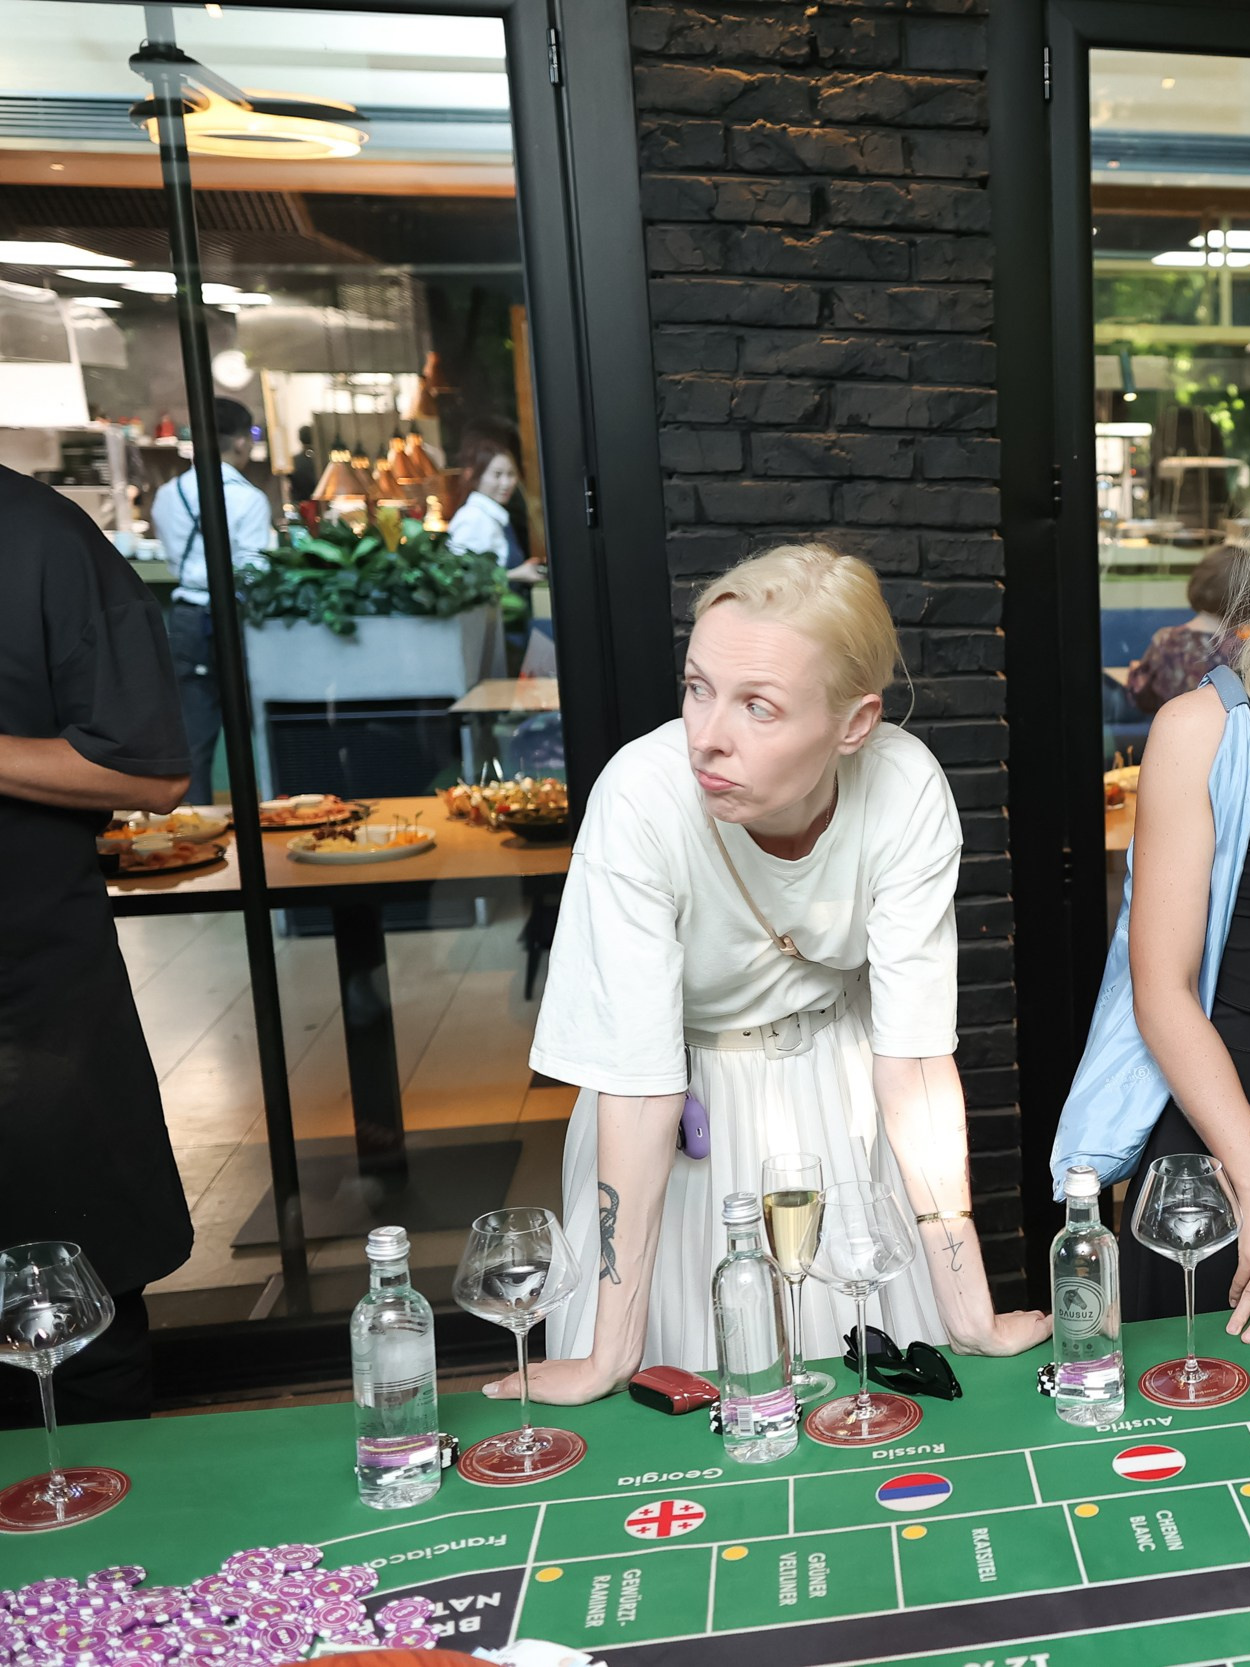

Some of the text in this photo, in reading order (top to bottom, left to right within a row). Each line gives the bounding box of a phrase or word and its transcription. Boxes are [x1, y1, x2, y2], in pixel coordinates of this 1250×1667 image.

[1058, 1308, 1094, 1319] DAUSUZ
[1096, 1415, 1173, 1433] Austria
[872, 1442, 945, 1460] Russia
[617, 1467, 723, 1487] Georgia
[1129, 1515, 1156, 1552] BLANC
[1155, 1509, 1184, 1551] CHENIN
[808, 1552, 831, 1599] GRÜNER
[971, 1527, 998, 1583] RKATSITELI
[616, 1568, 642, 1627] GEWÜRZT-
[778, 1552, 798, 1607] VELTLINER
[585, 1575, 612, 1629] RAMINER
